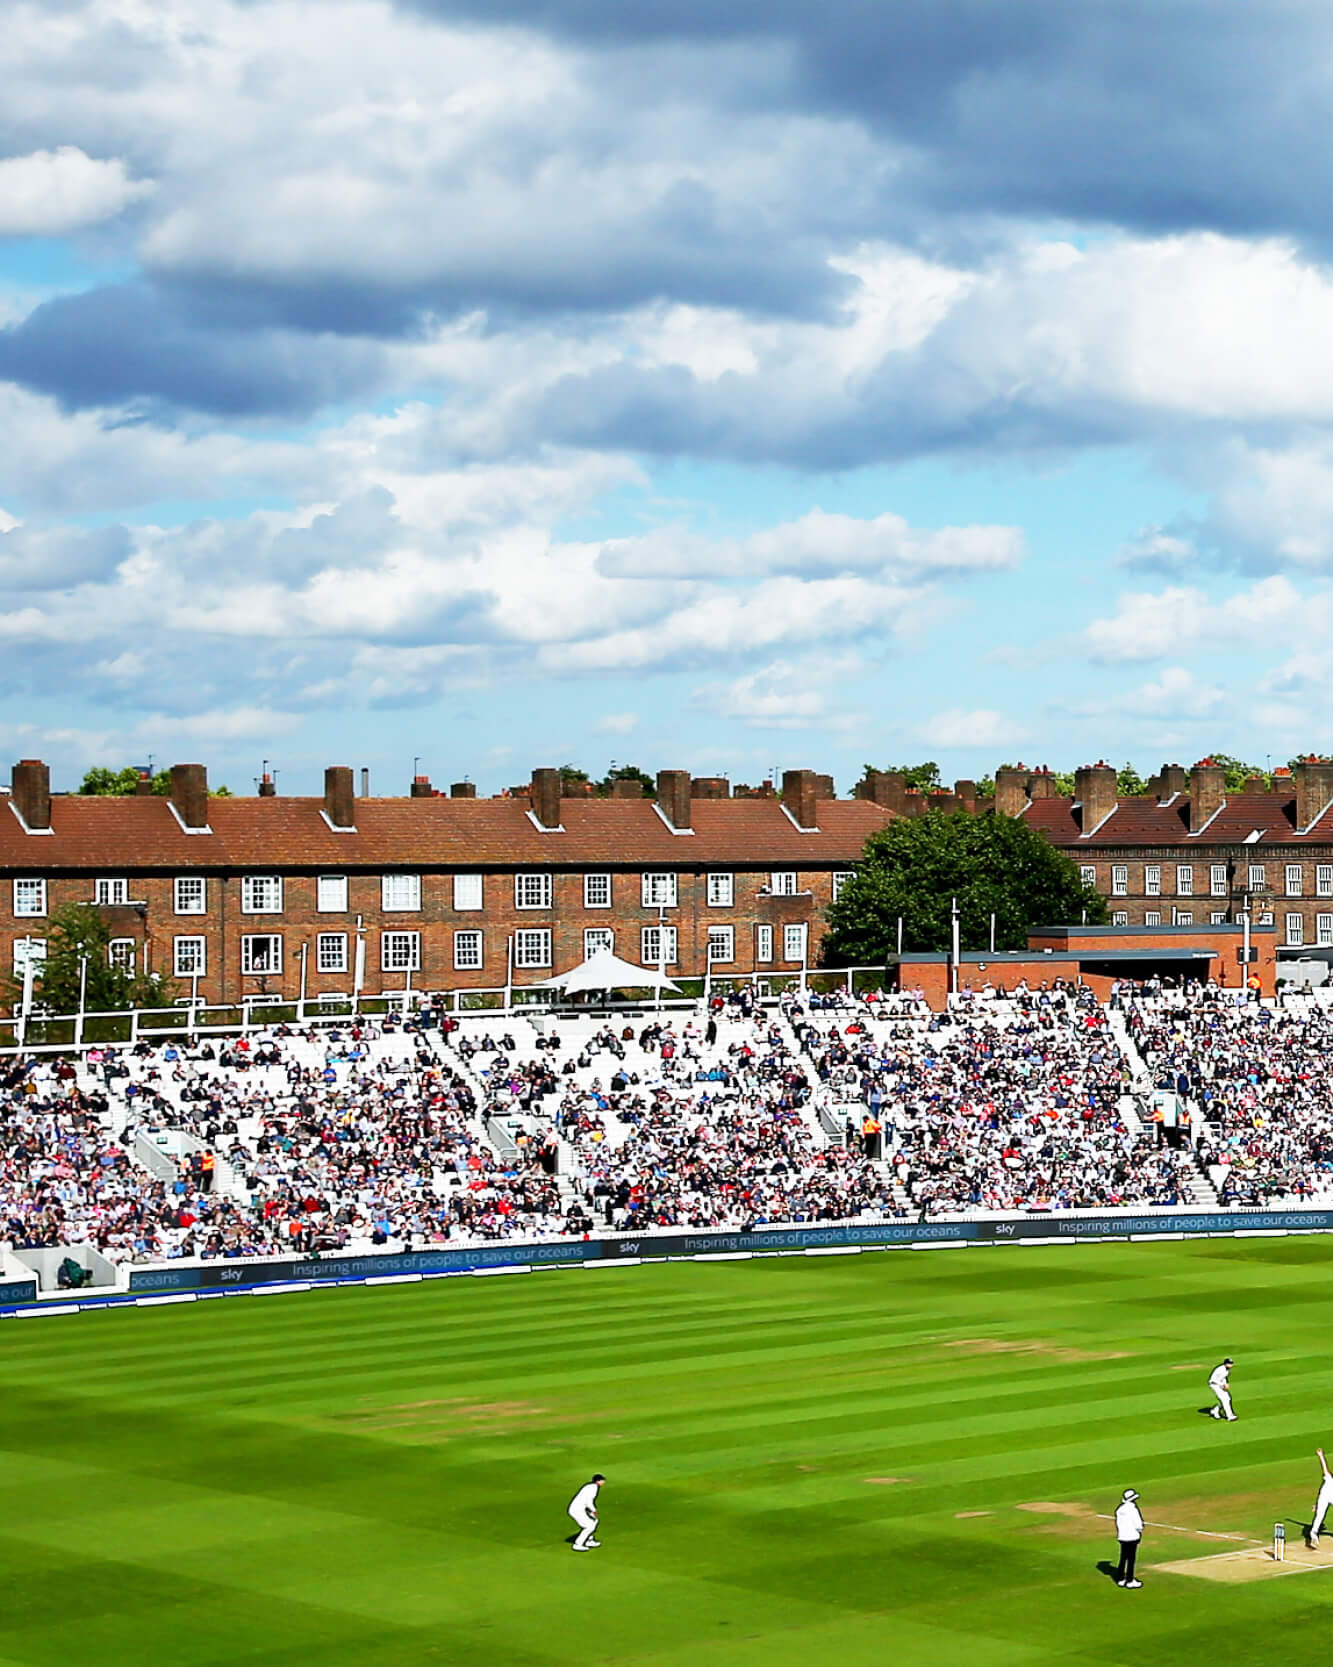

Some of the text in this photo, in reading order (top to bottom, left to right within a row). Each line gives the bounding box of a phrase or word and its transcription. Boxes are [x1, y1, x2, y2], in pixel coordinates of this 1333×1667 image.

[995, 1223, 1016, 1236] sky
[1059, 1213, 1327, 1234] Inspiring millions of people to save our oceans
[739, 1231, 784, 1246] millions
[787, 1230, 800, 1244] of
[802, 1228, 842, 1247] people
[845, 1228, 858, 1240] to
[861, 1228, 891, 1240] save
[893, 1227, 914, 1238] our
[917, 1225, 961, 1238] oceans
[619, 1242, 640, 1254] sky
[293, 1246, 583, 1277] Inspiring millions of people to save our oceans
[221, 1268, 244, 1281] sky
